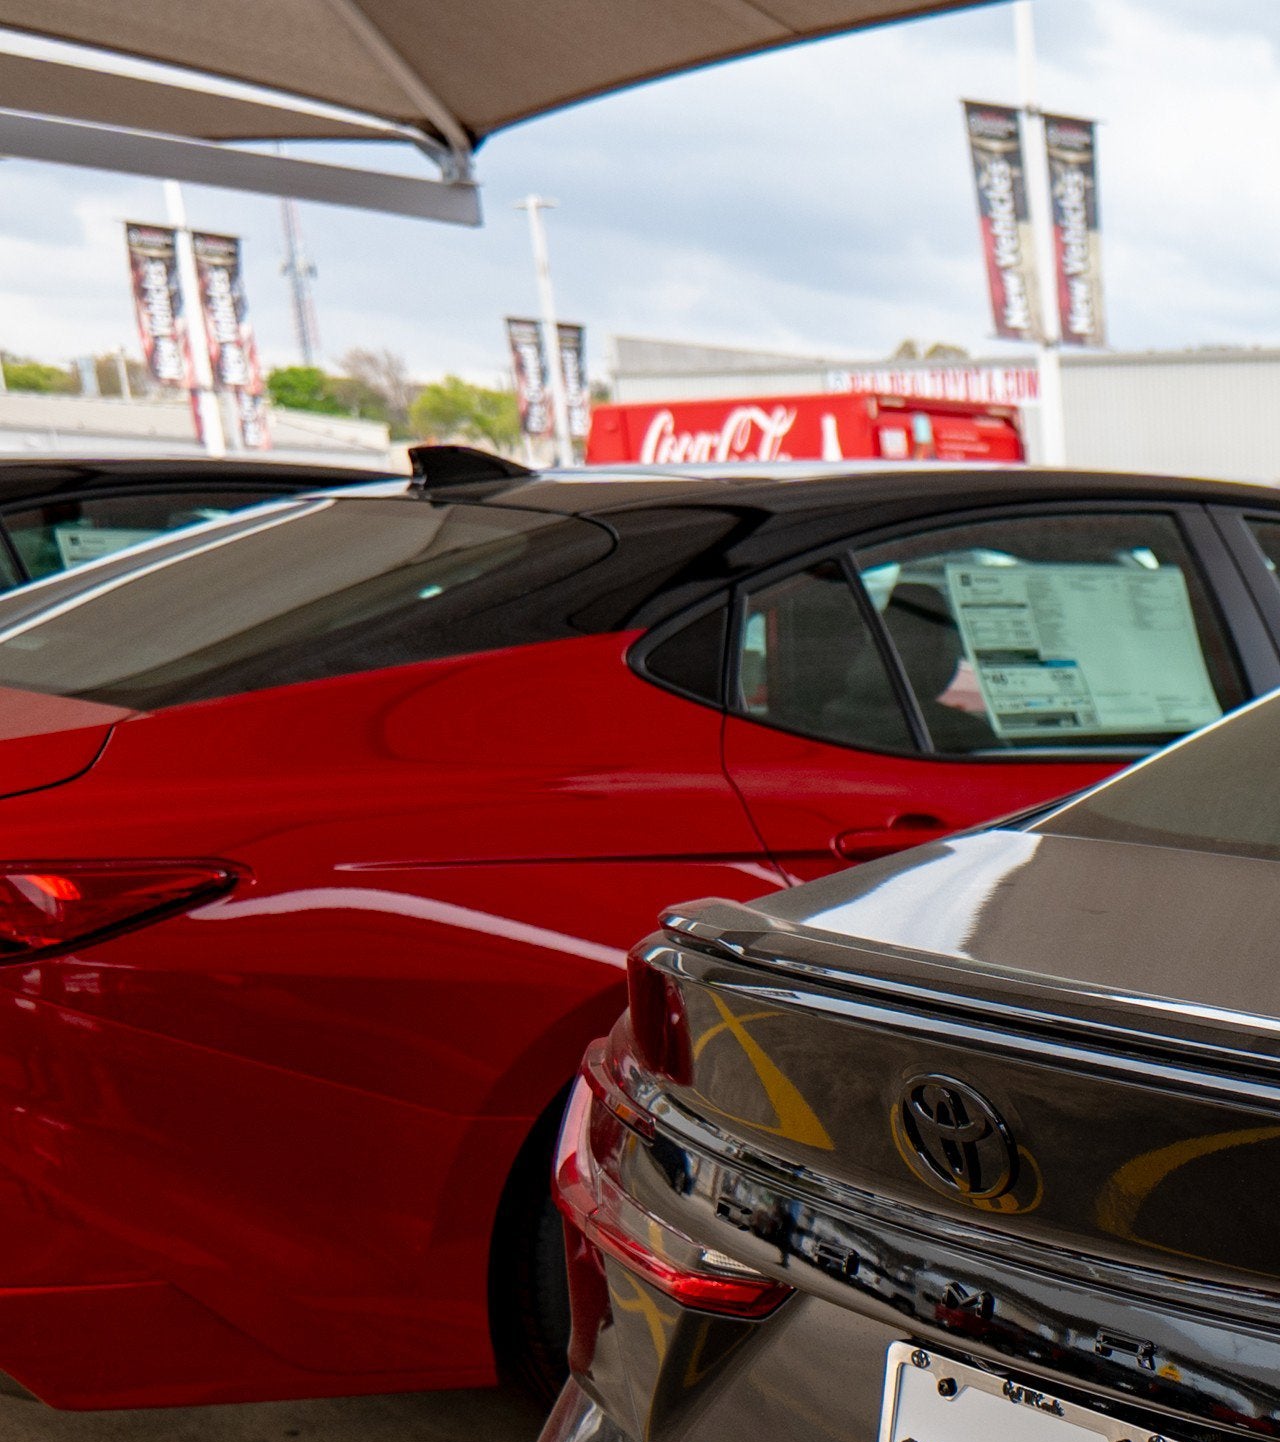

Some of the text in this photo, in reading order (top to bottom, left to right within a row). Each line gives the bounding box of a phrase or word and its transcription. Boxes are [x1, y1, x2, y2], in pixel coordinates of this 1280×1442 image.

[984, 158, 1022, 268] Vehicles
[1058, 168, 1090, 276] Vehicles
[1002, 269, 1030, 330] New
[1069, 277, 1095, 335] New
